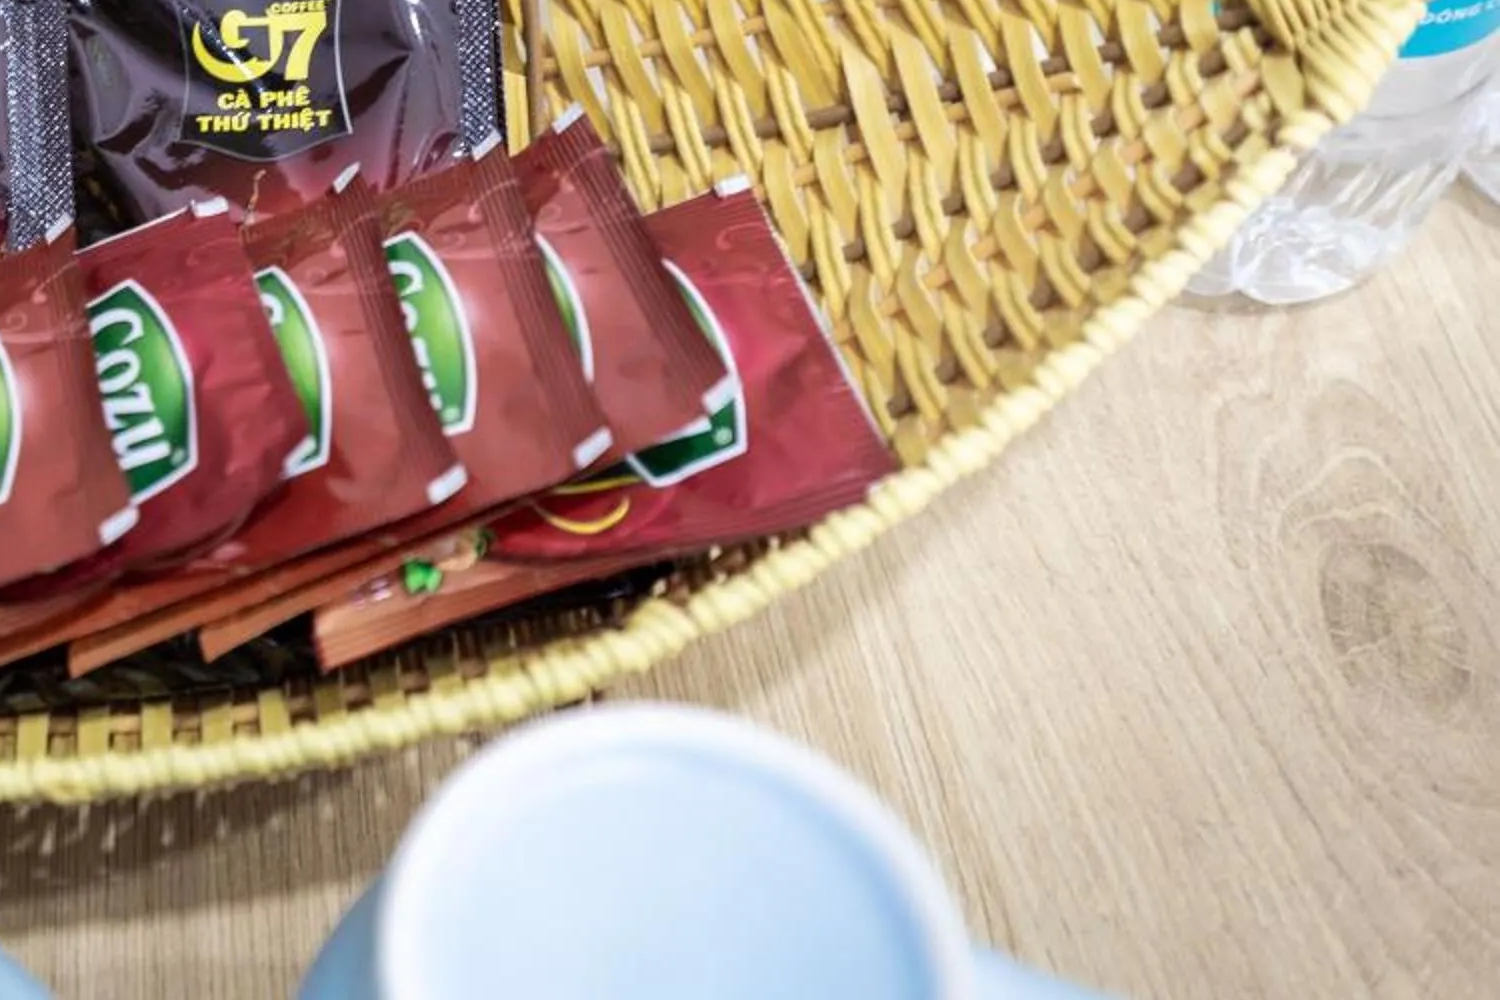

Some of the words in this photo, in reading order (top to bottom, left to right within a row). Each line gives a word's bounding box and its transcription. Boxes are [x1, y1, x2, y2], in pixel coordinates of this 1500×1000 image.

[269, 0, 326, 14] COFFEE
[191, 9, 327, 83] G7
[217, 88, 252, 110] CÀ
[259, 85, 310, 108] PHÊ
[256, 107, 332, 132] THIỆT
